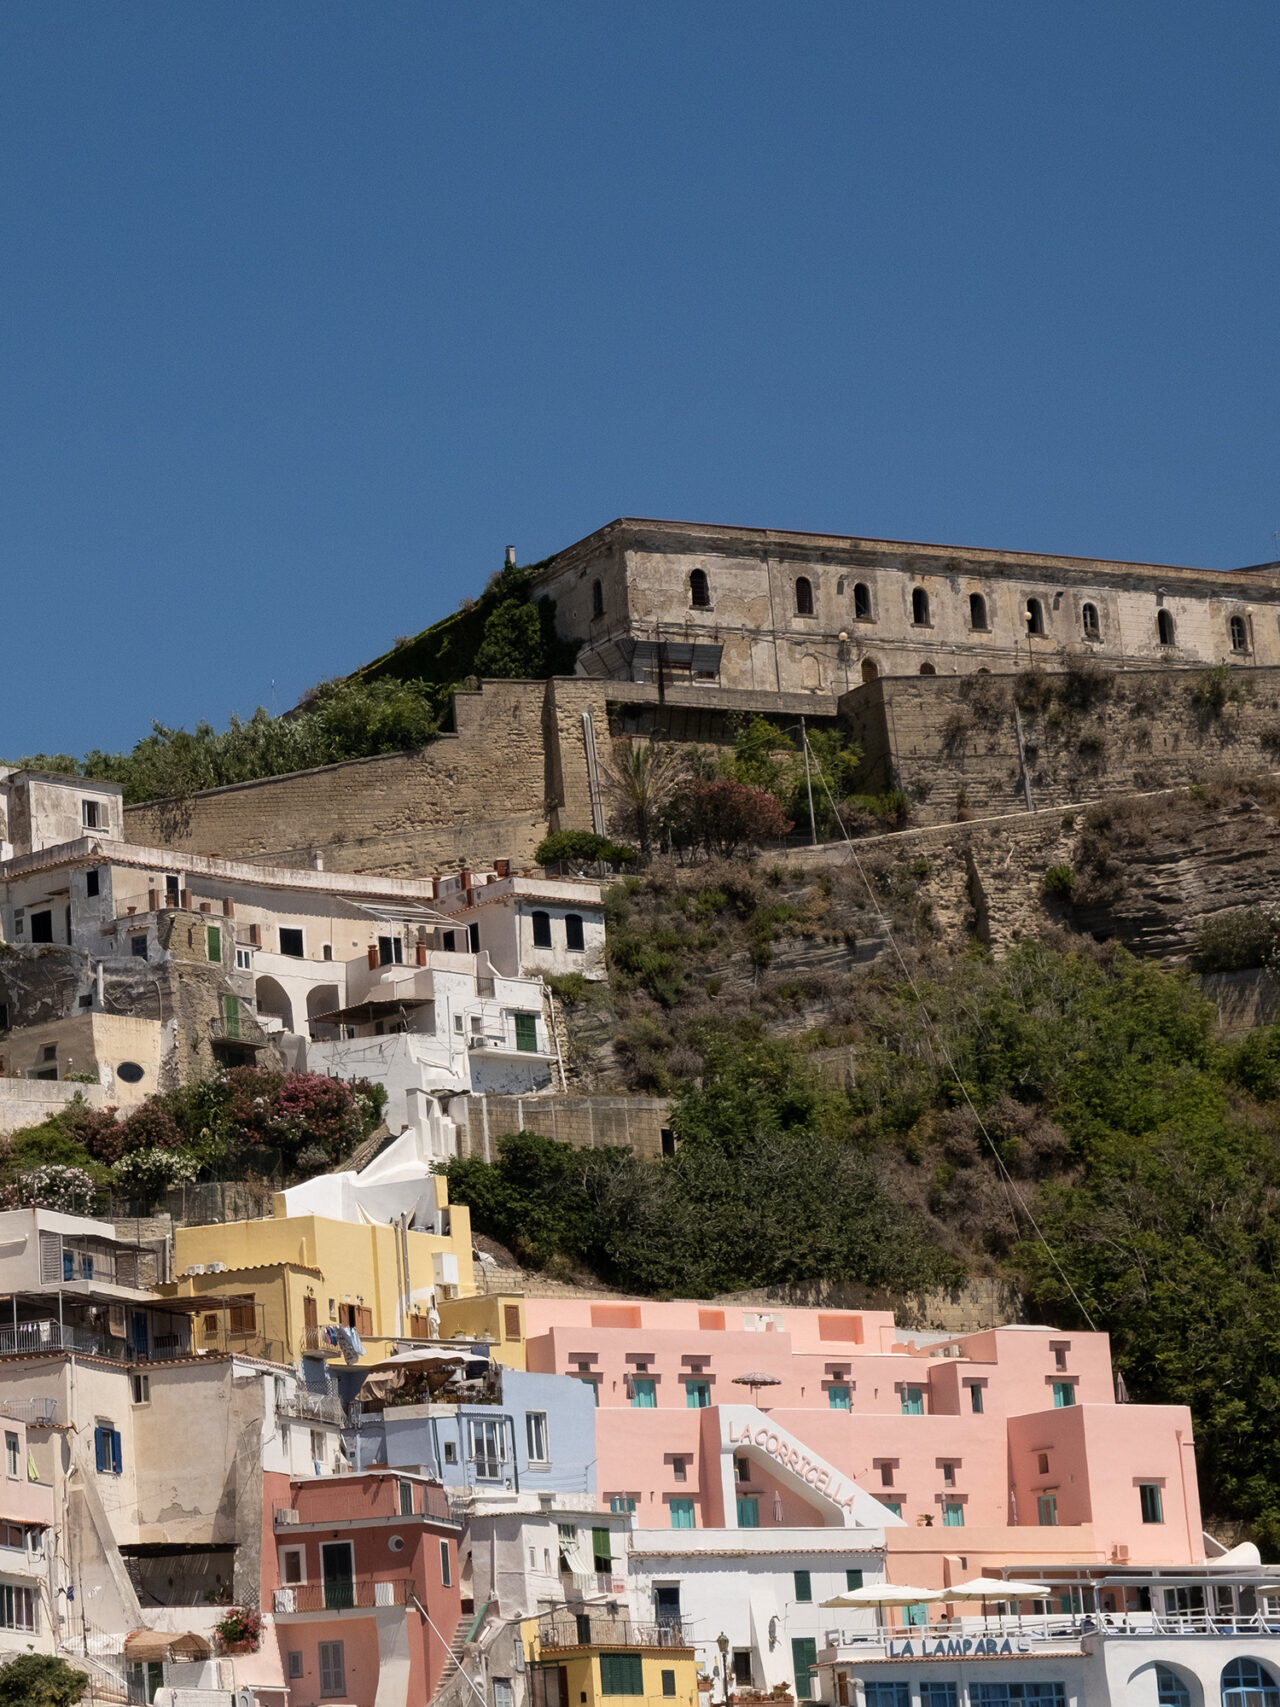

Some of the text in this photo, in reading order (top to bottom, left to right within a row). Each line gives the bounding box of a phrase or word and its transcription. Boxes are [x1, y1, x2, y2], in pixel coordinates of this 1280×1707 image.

[729, 1421, 855, 1514] LA CORRICELLA
[890, 1638, 1012, 1658] LA LAMPARA
